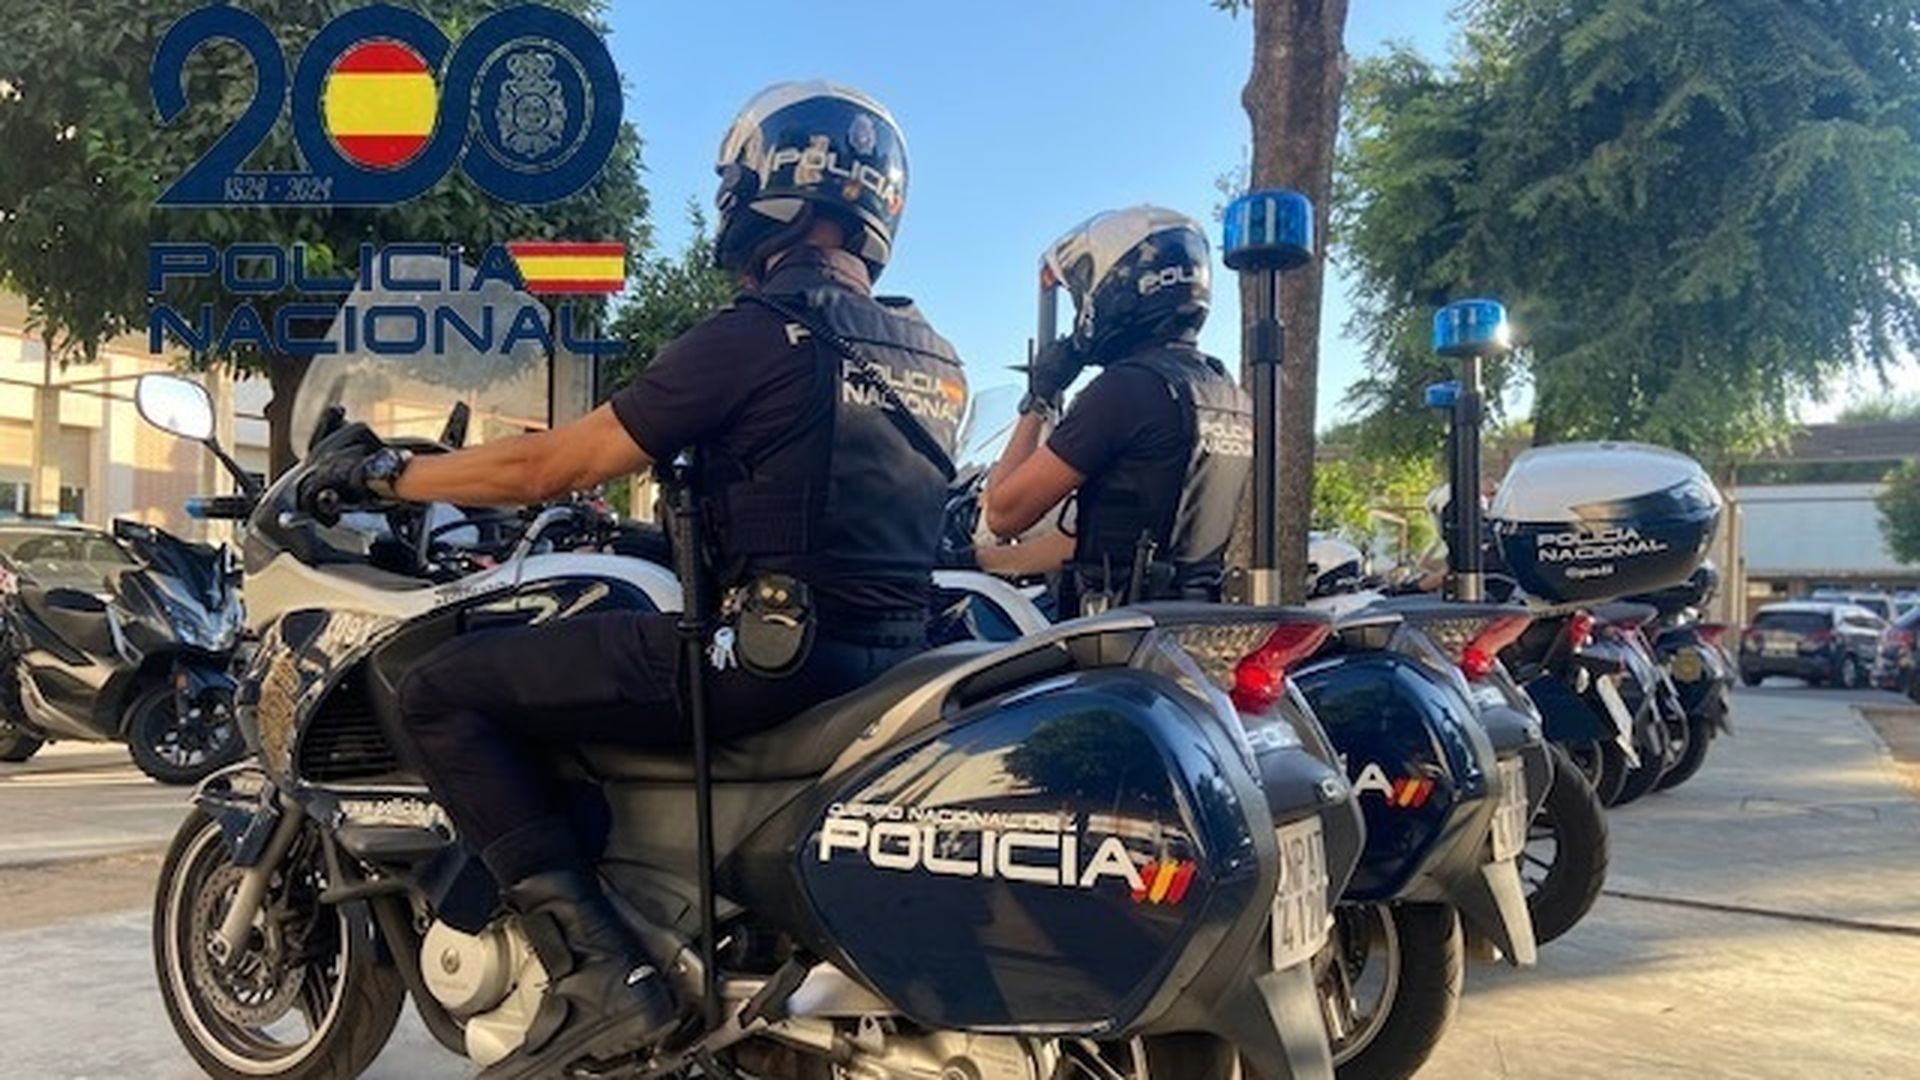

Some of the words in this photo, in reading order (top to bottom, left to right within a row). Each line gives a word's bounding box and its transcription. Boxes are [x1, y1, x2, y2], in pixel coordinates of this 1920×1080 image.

[772, 147, 899, 200] POLICIA
[1537, 527, 1641, 547] POLICIA
[1538, 540, 1669, 561] NACIONAL
[819, 818, 1147, 892] POLICIA
